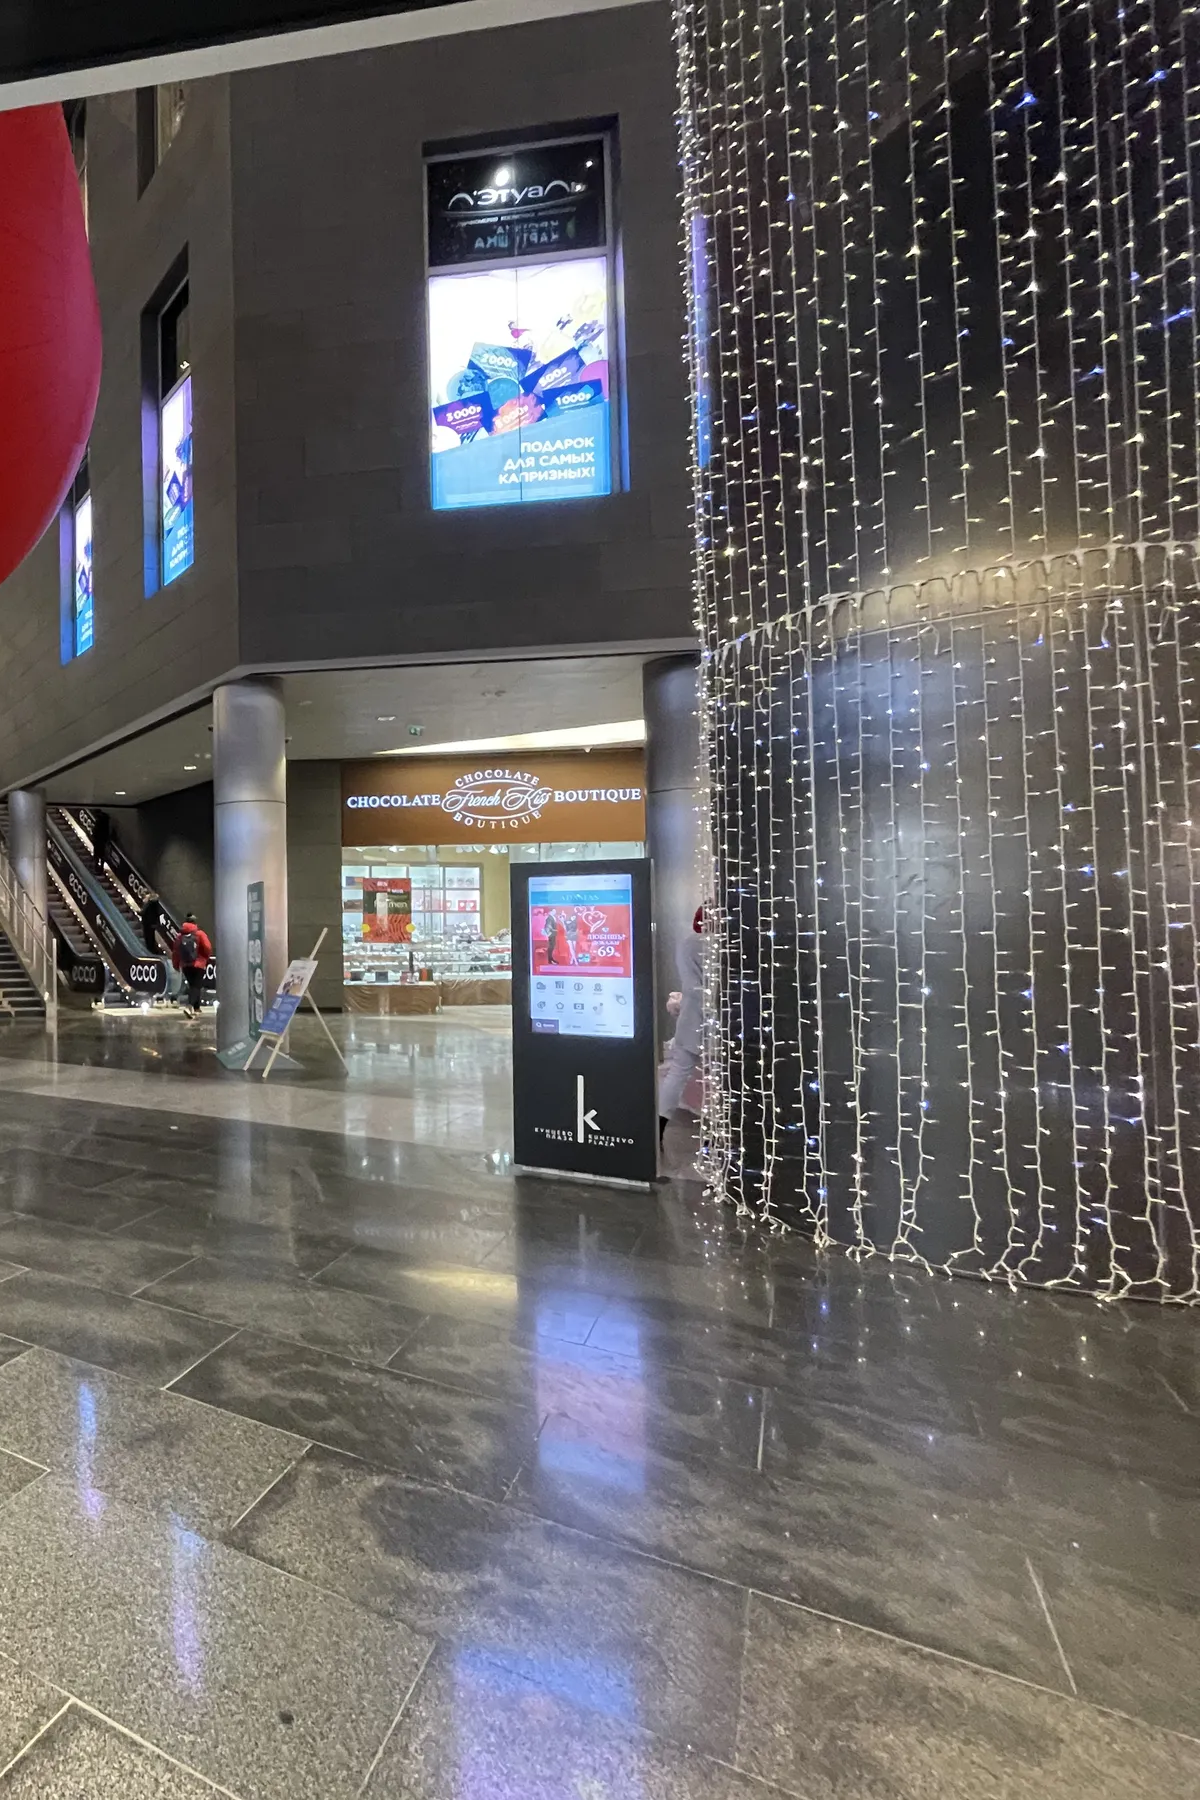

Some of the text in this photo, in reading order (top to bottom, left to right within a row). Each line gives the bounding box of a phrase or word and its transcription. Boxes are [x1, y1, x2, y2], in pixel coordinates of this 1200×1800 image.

[520, 436, 595, 453] ПОДАРОК
[503, 452, 595, 471] ДЛЯ САМЫХ
[498, 467, 596, 485] КАПРИЗНЫХ!
[455, 769, 540, 788] CHOCOLATE
[346, 786, 642, 813] CHOCOLATE French Kiss BOUTIQUE
[453, 810, 542, 829] BOUTIQUE
[69, 873, 87, 905] ecco
[71, 965, 98, 982] ecco
[130, 964, 157, 982] ecco
